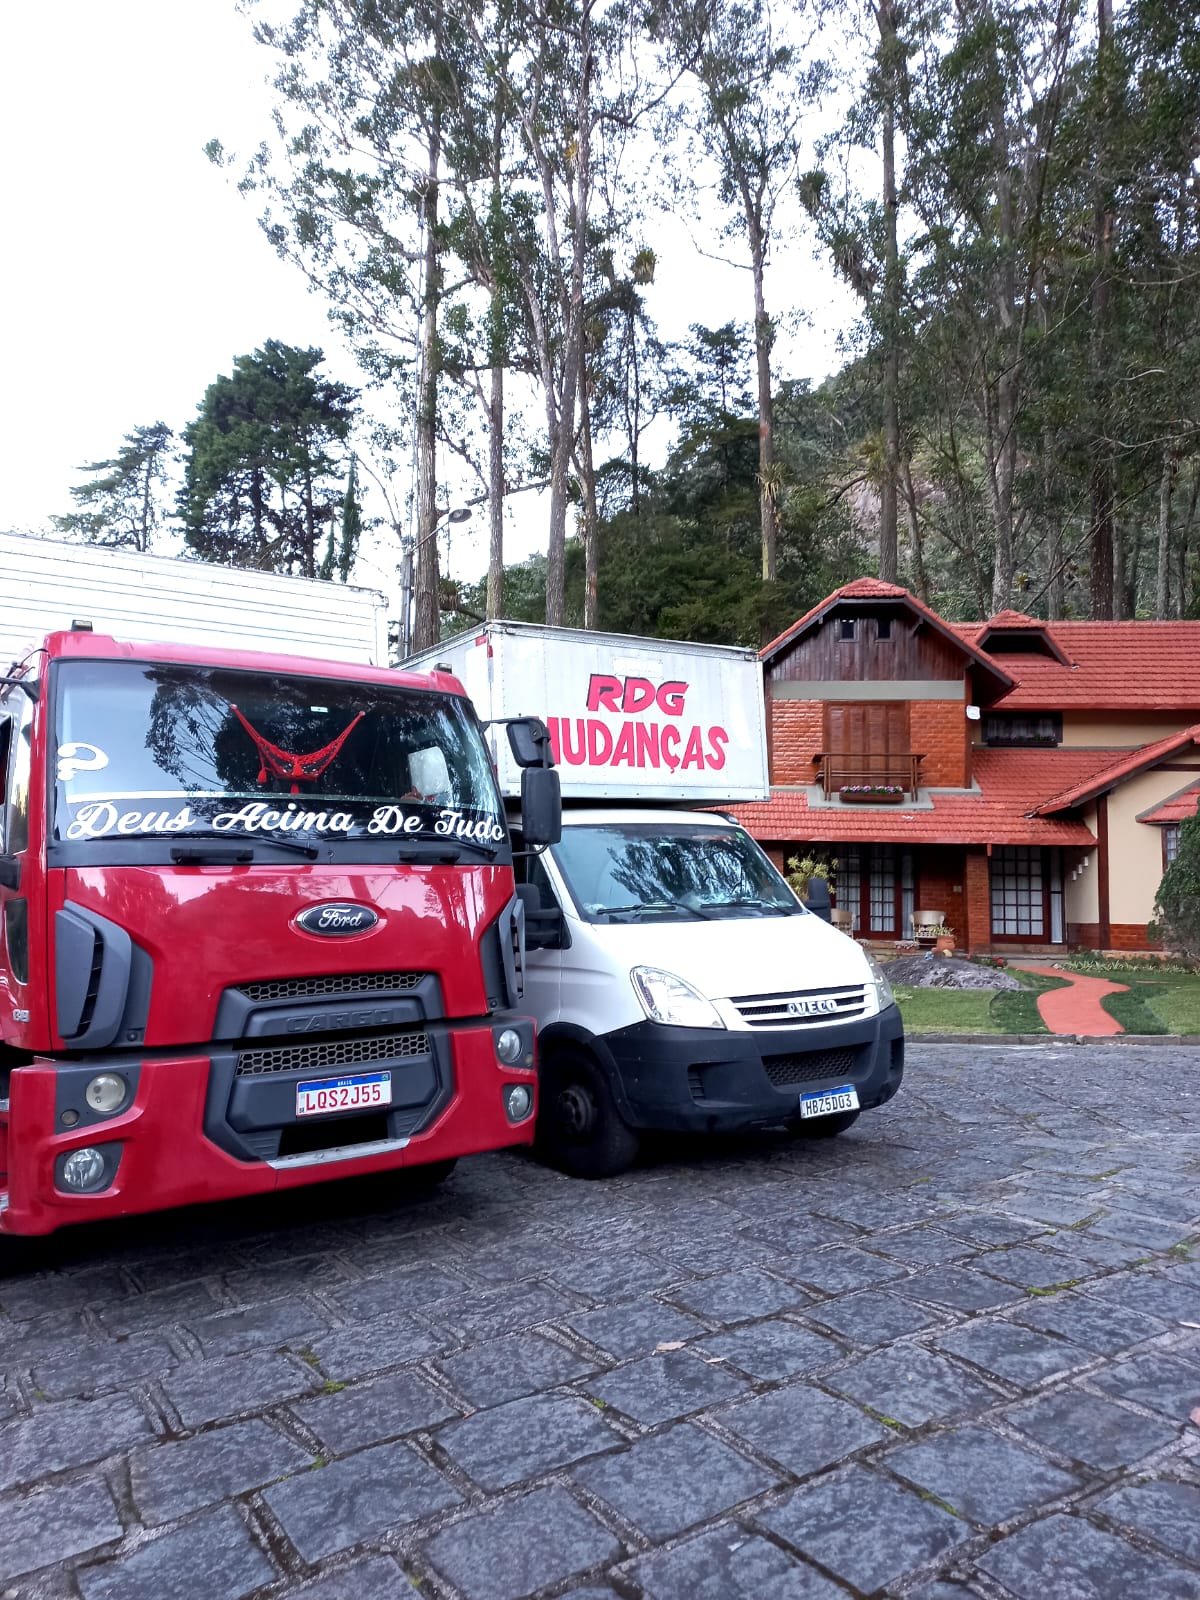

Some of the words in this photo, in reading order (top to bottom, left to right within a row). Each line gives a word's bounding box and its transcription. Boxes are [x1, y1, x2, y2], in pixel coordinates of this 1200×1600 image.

[586, 673, 690, 717] RDG
[66, 801, 197, 840] Deus
[211, 802, 354, 833] Acima
[367, 804, 424, 834] De
[434, 808, 505, 842] Tudo
[318, 908, 363, 928] Ford
[787, 999, 838, 1016] IVECO
[285, 1008, 394, 1034] CARGO
[305, 1083, 381, 1111] LQS2J55
[805, 1093, 852, 1116] HBZ5D03
